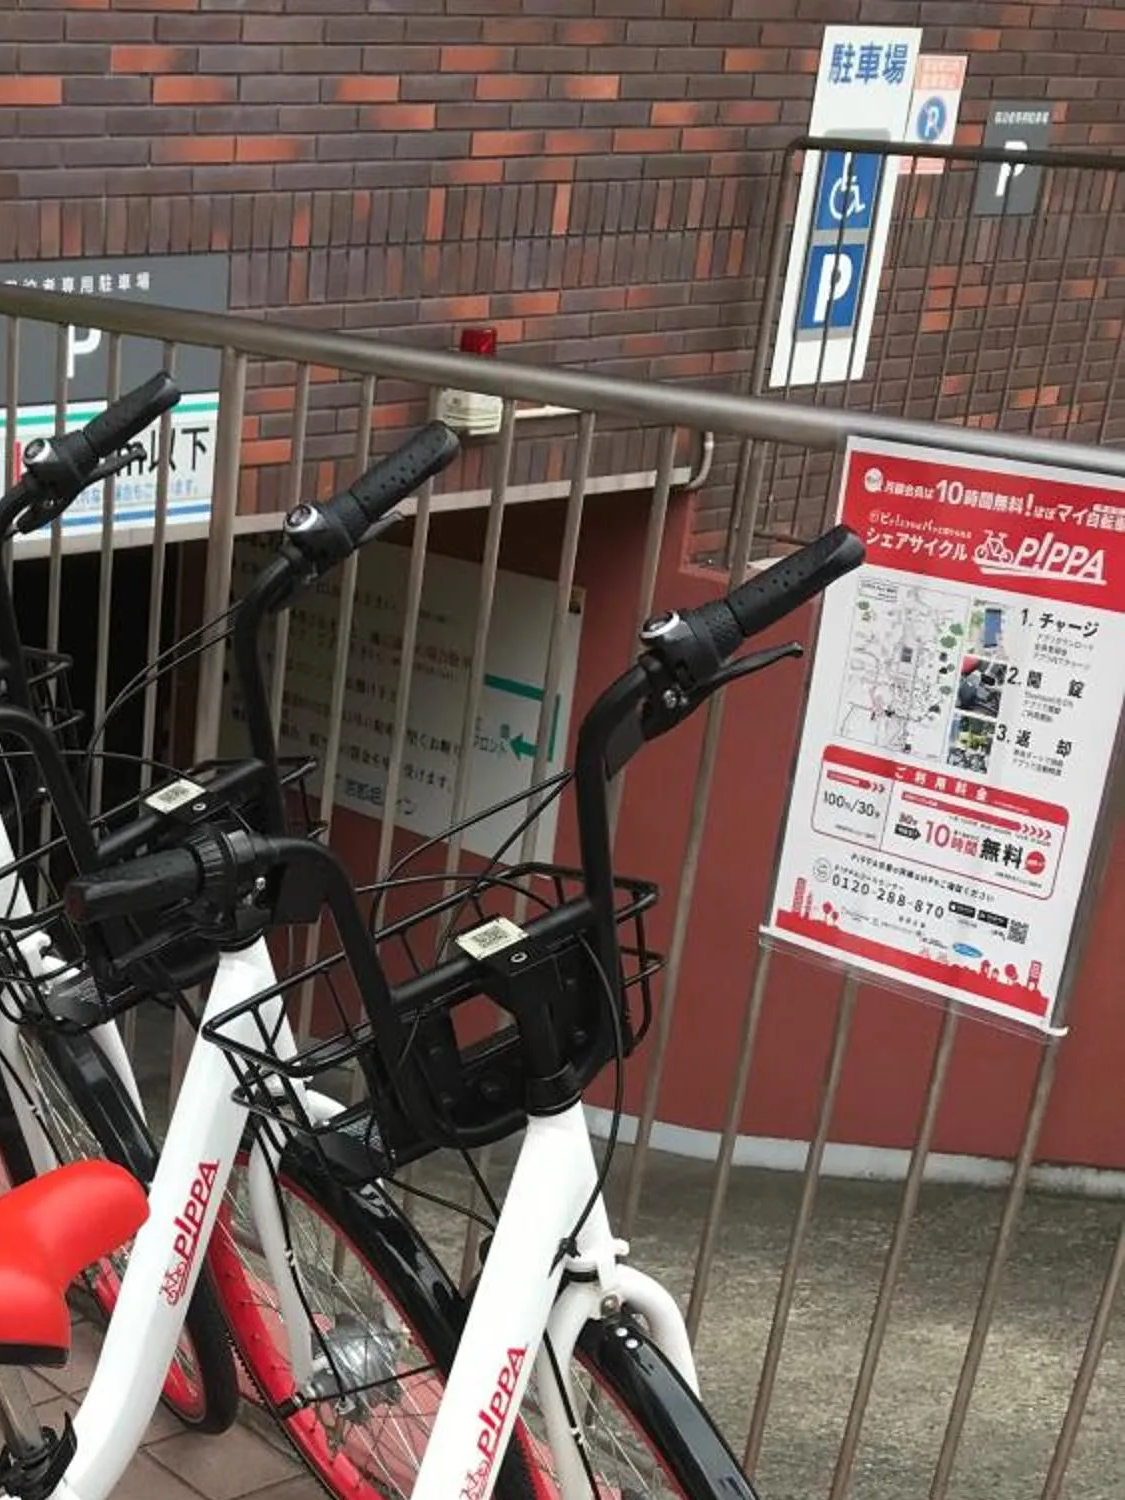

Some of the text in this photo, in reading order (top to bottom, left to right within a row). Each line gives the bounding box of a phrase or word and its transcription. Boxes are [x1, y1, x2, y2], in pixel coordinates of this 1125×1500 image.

[828, 43, 908, 84] 駐車場
[4, 271, 150, 294] 者専用駐車場
[813, 253, 853, 322] P
[866, 527, 968, 561] シェアサイクル
[1039, 612, 1100, 638] チャージ
